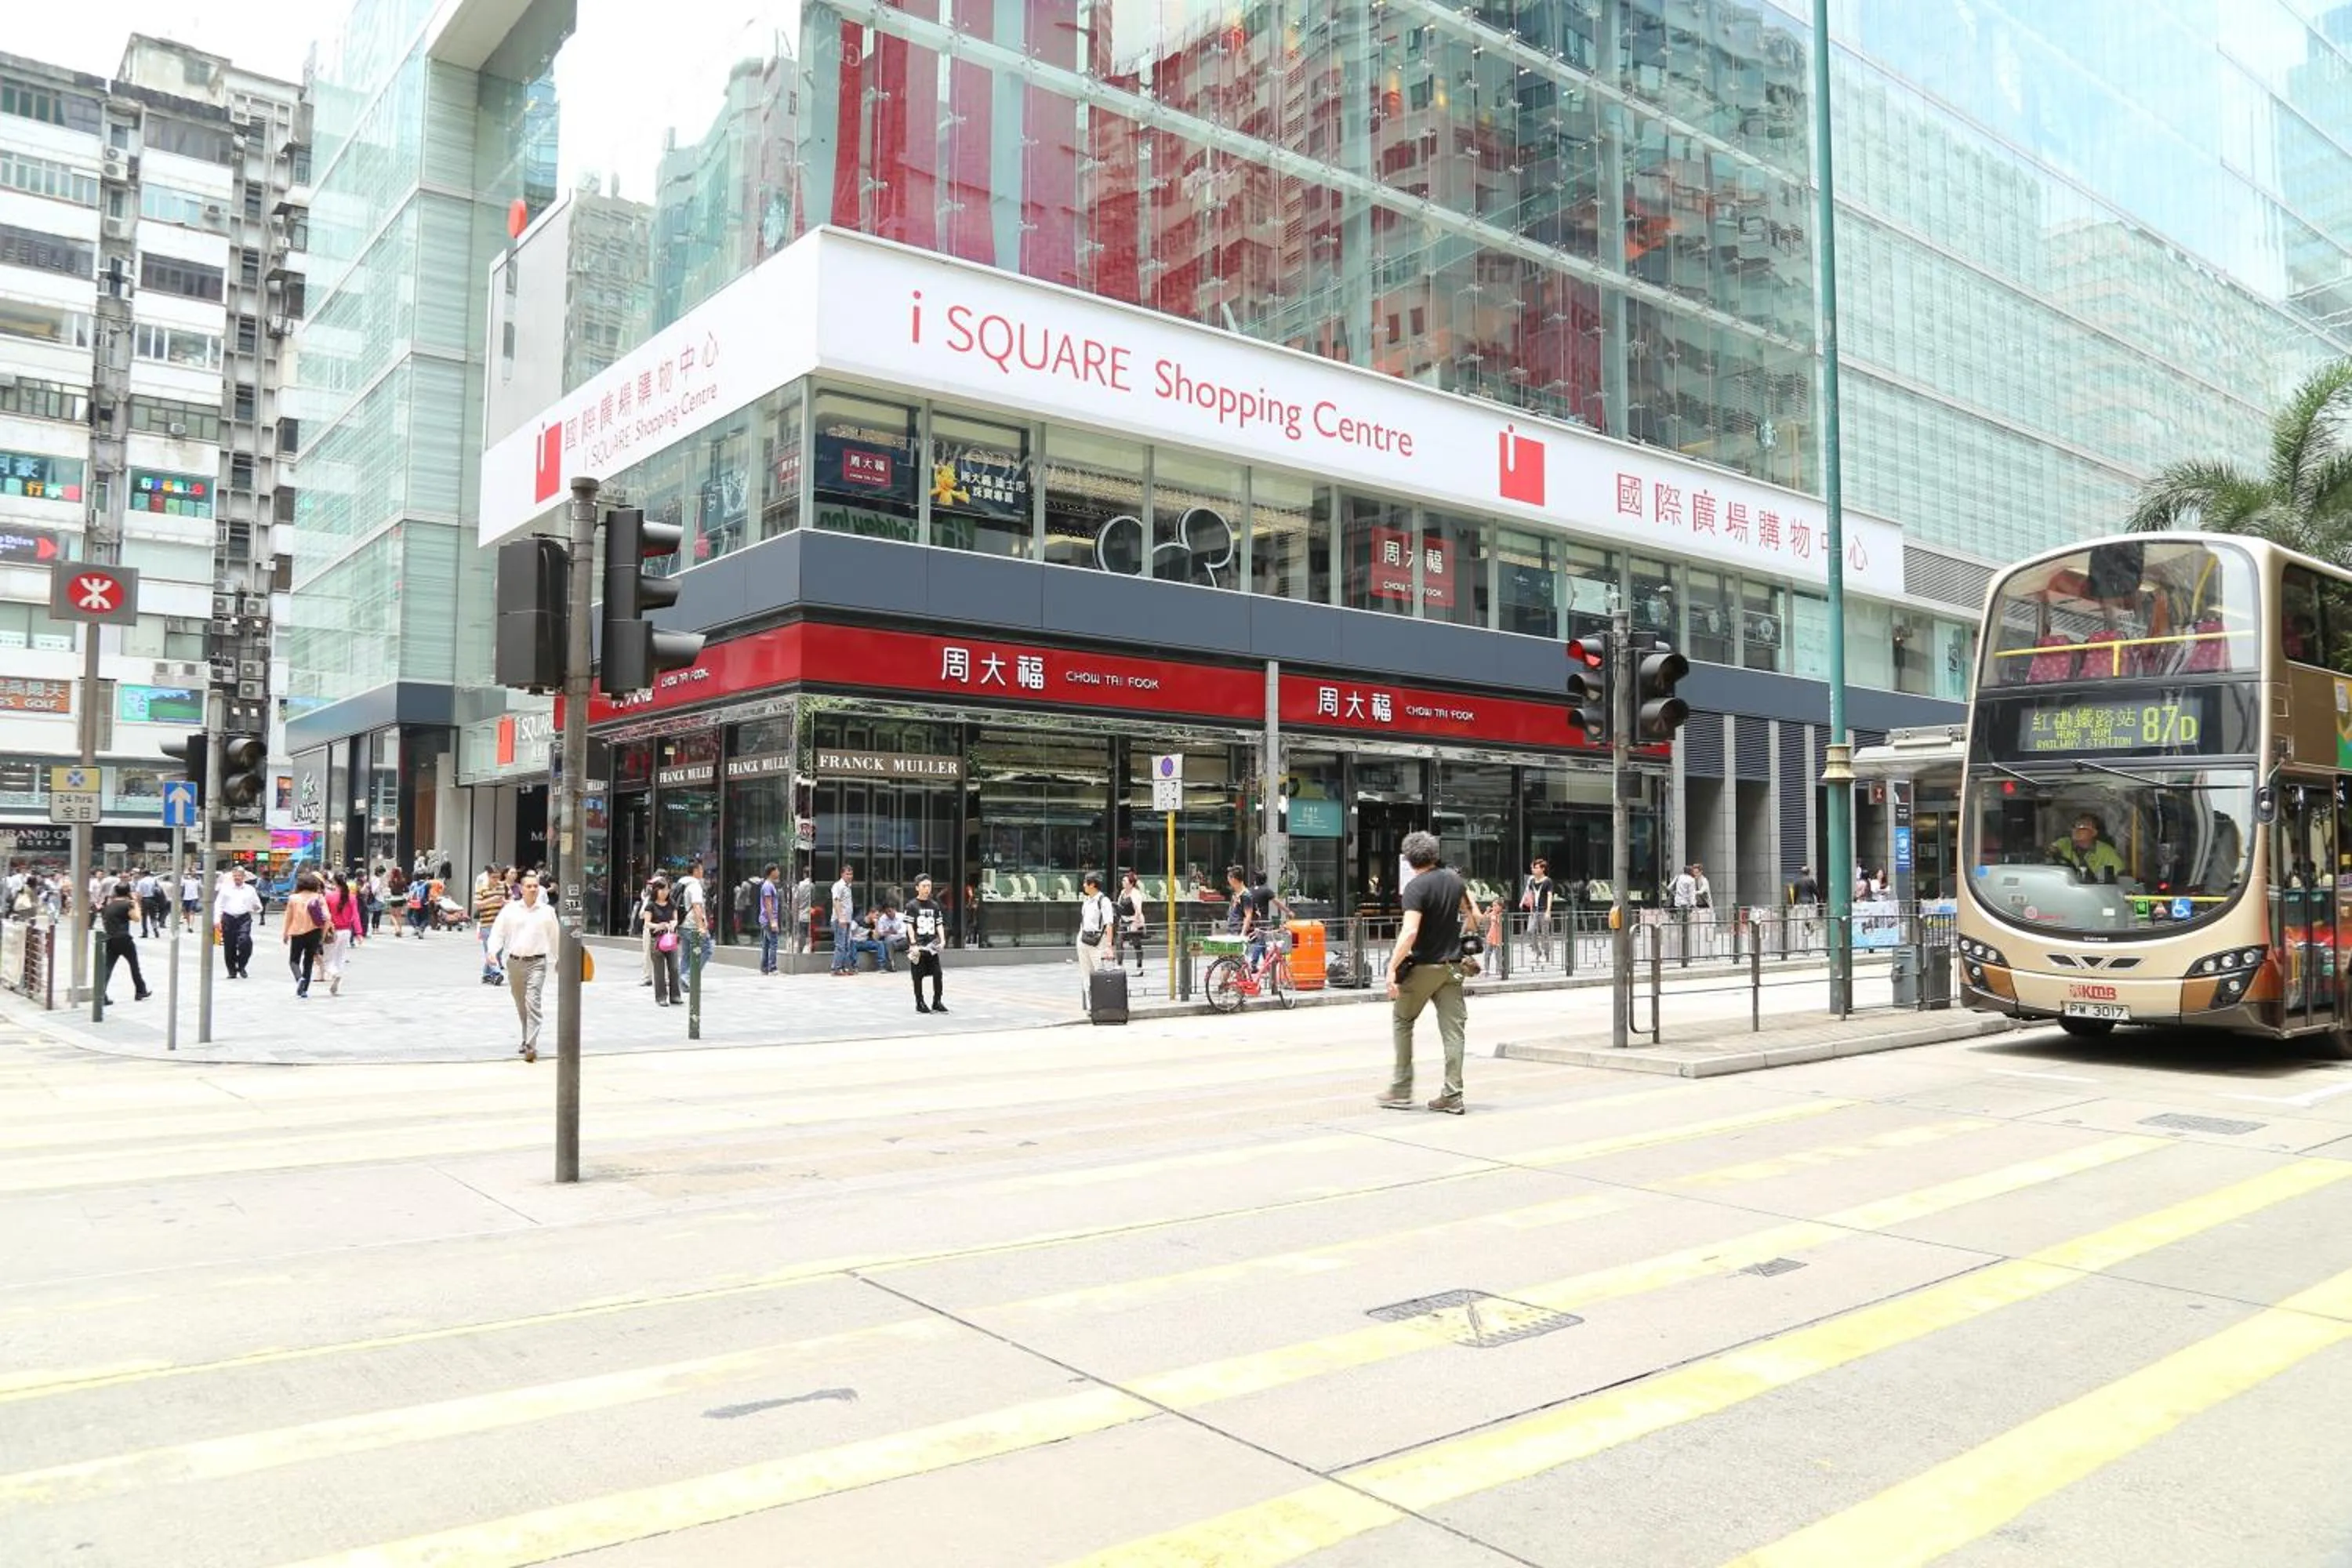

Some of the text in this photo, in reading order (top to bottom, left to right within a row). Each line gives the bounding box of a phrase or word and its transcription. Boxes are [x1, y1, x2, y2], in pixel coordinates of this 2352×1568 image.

[912, 290, 1414, 457] i SQUARE Shopping Centre
[590, 425, 630, 468] SQUARE
[634, 405, 679, 441] Shopping
[681, 383, 718, 416] Centre
[1383, 580, 1406, 592] CHOW
[1422, 587, 1443, 597] OOK
[941, 646, 1045, 690] 周大福
[1065, 670, 1160, 690] CHOW TAI FOOK
[1318, 686, 1392, 723] 周大福
[1406, 705, 1475, 721] CHOW TAI FOOK
[2142, 705, 2198, 742] 87D
[2056, 727, 2112, 739] HUNG HOM
[2085, 736, 2132, 748] STATION
[728, 756, 789, 775] FRANCK MULLE
[818, 754, 958, 775] FRANCK MULLER
[59, 794, 93, 804] 24 hrs
[61, 806, 91, 819] 全日
[2083, 985, 2118, 1000] KMB
[2070, 1004, 2124, 1018] PW 3017
